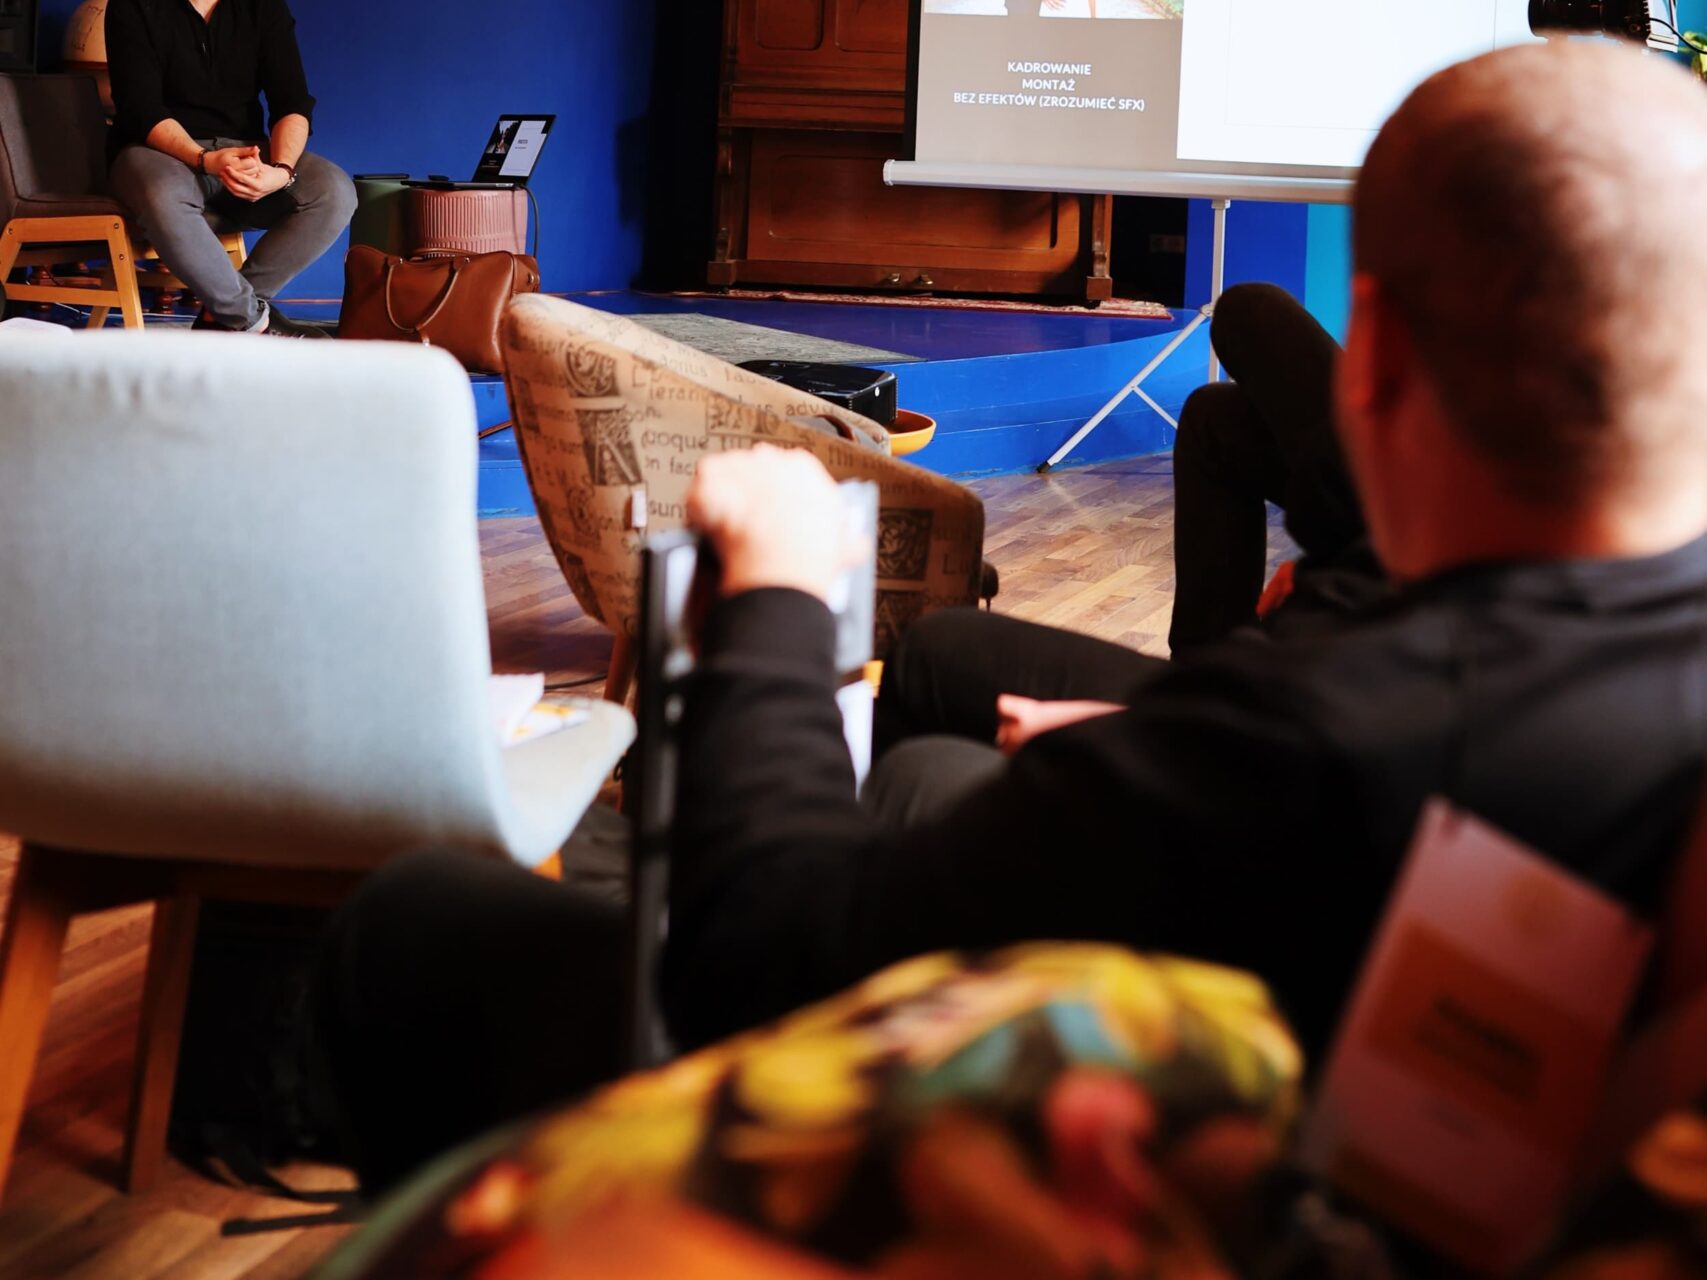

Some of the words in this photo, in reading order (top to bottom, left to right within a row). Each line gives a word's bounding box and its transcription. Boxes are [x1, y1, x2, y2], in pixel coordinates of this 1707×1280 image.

[1007, 62, 1092, 75] KADROWANIE
[1022, 78, 1076, 91] MONTAŻ
[953, 92, 976, 103] BEZ
[979, 93, 1037, 106] EFEKTÓW
[1039, 96, 1116, 109] (ZROZUMIEĆ
[1118, 99, 1145, 112] SFX)
